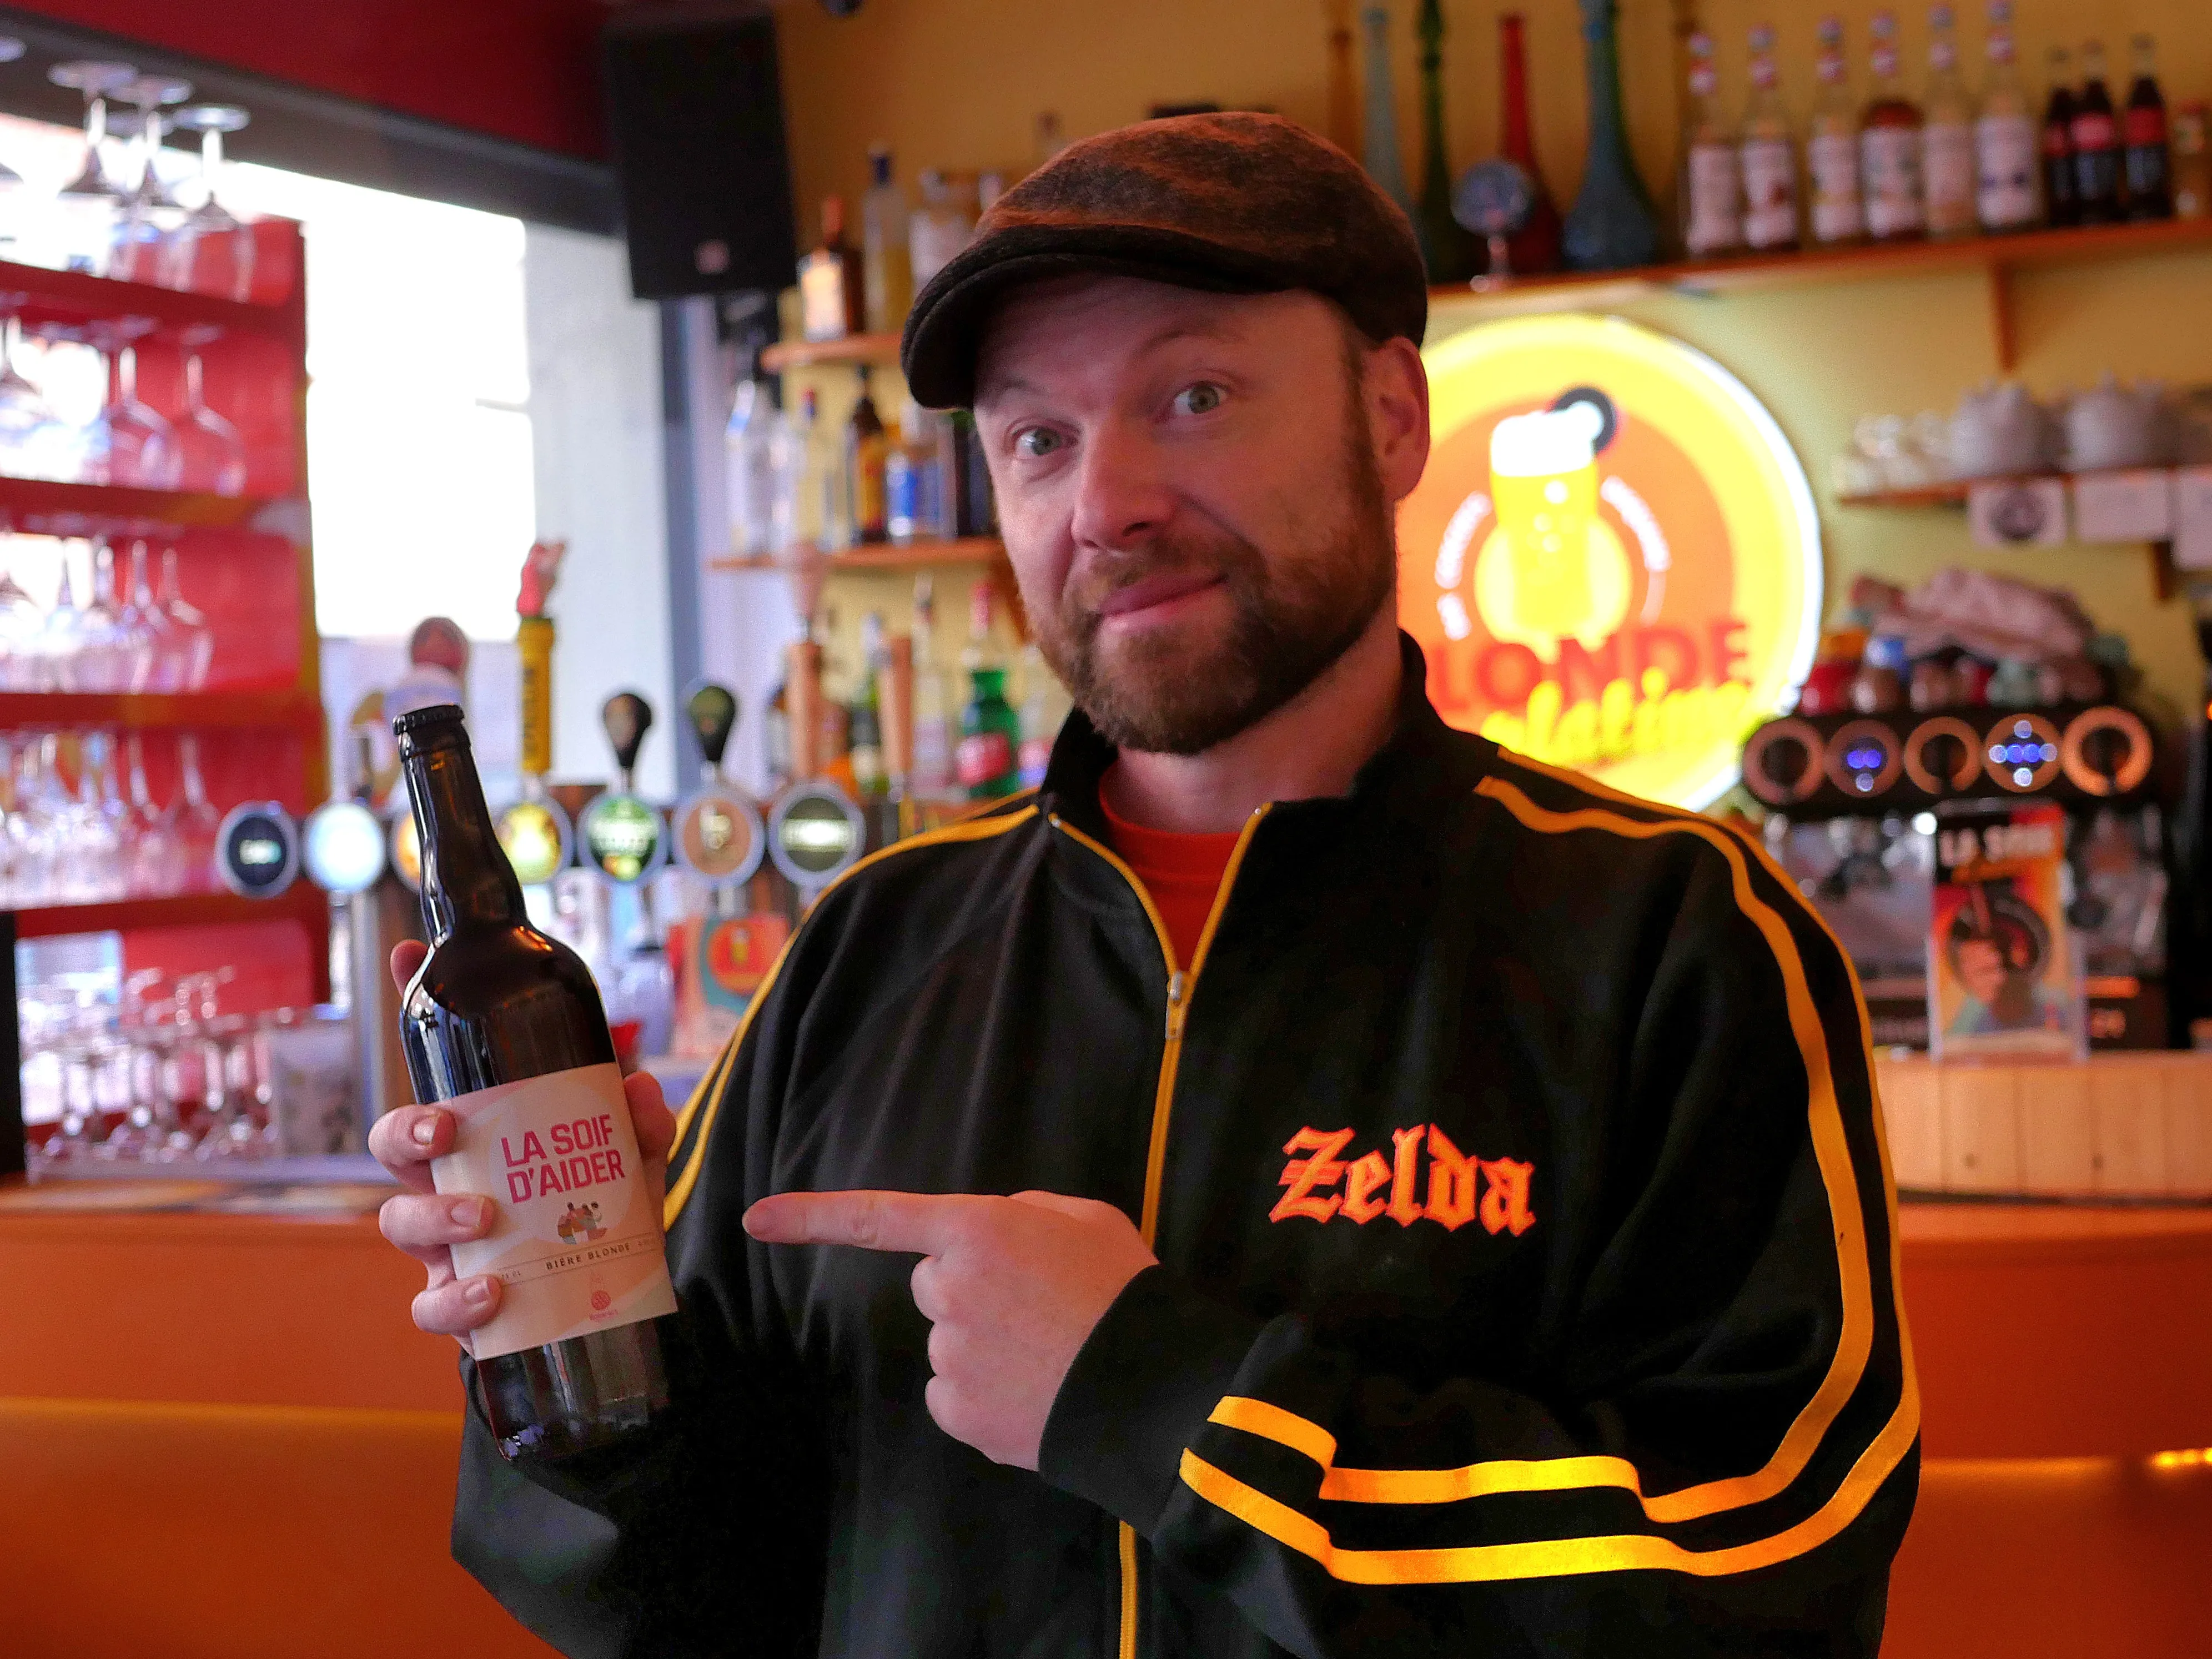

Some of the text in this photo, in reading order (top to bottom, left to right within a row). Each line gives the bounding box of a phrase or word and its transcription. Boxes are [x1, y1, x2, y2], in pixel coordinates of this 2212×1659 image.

[1429, 615, 1752, 712] LONDE
[501, 1114, 613, 1168] LA SOIF
[507, 1149, 625, 1204] D'AIDER
[1269, 1123, 1536, 1237] Zelda
[546, 1243, 630, 1270] BIÈRE BLONDE
